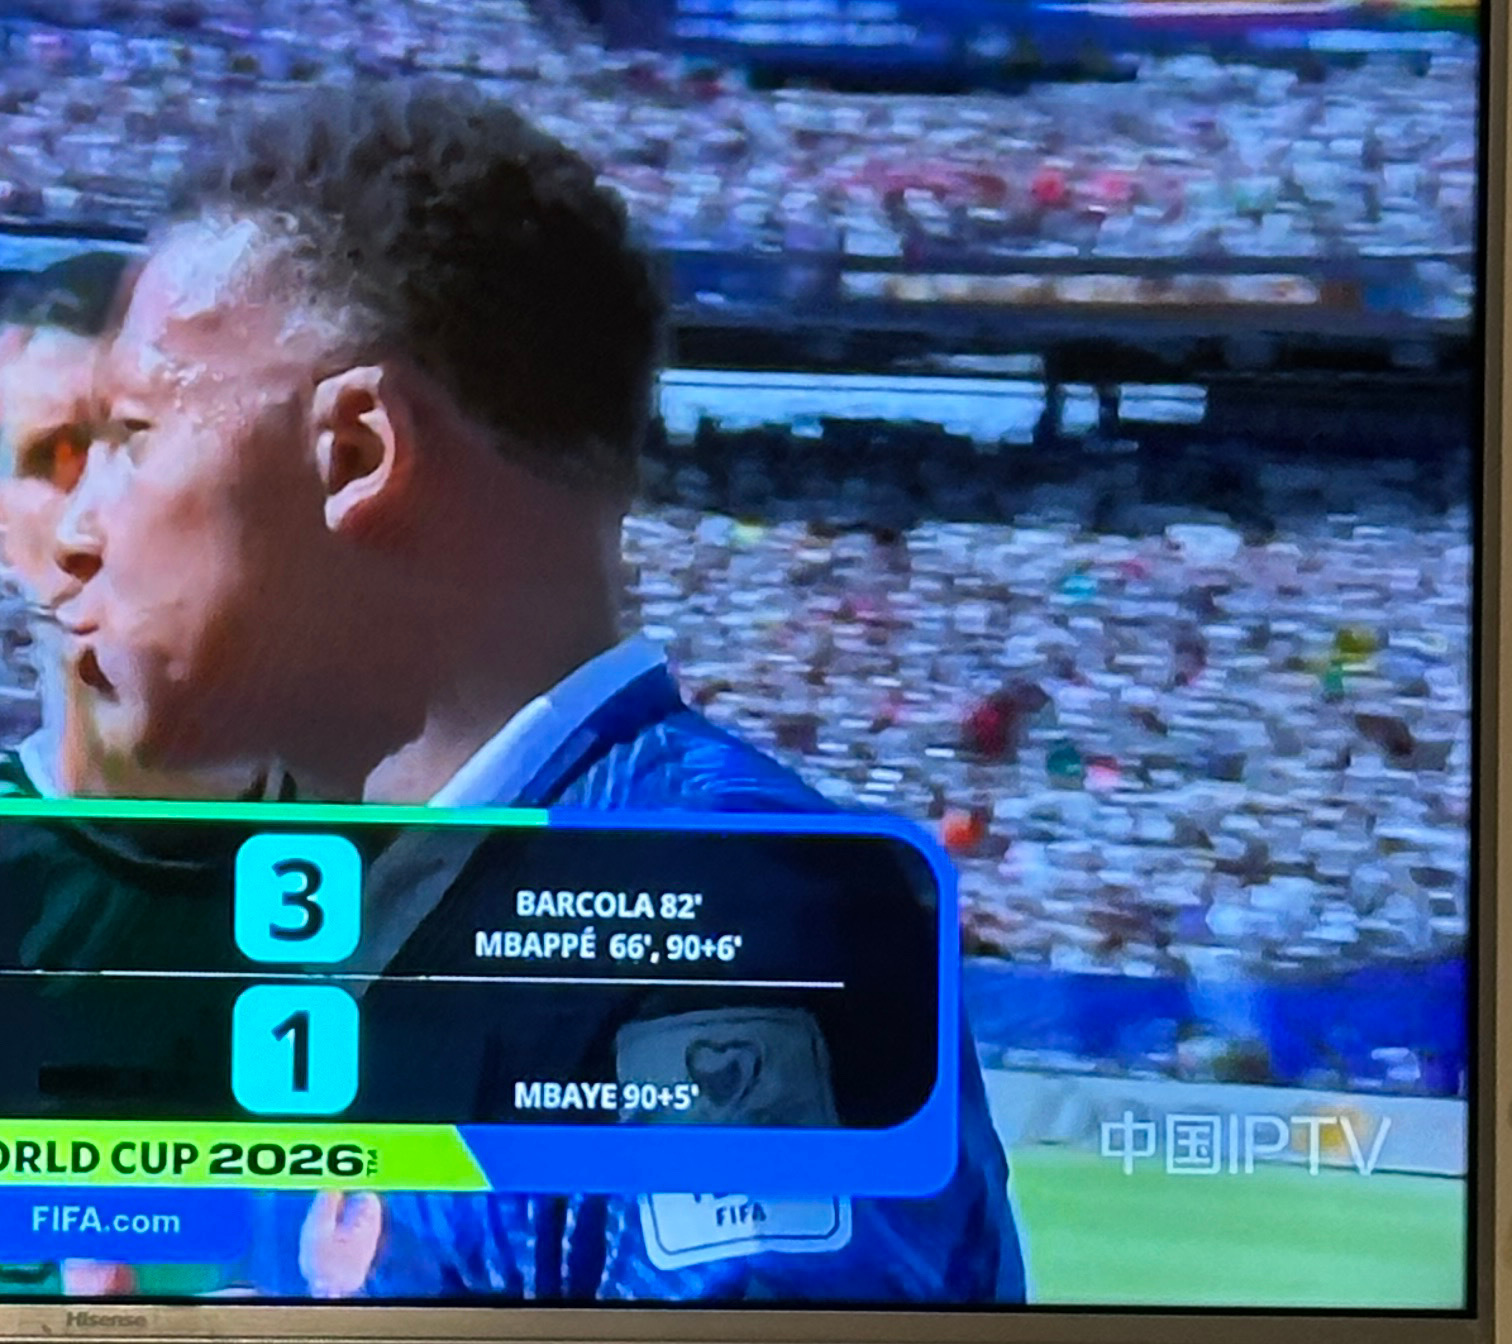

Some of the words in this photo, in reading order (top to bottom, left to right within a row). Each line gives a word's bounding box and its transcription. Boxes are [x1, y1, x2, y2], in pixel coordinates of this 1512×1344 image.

[268, 858, 324, 942] 3
[516, 890, 655, 919] BARCOLA
[660, 892, 704, 920] 82'
[475, 926, 597, 959] MBAPPÉ
[666, 934, 743, 962] 90+6'
[269, 1010, 312, 1093] 1
[514, 1081, 618, 1110] MBAYE
[624, 1083, 700, 1111] 90+5'
[111, 1141, 198, 1176] CUP
[1101, 1110, 1393, 1178] 中国IPTV
[32, 1205, 181, 1234] FIFA.com
[715, 1202, 766, 1226] FIFA
[66, 1311, 148, 1327] Hisense
